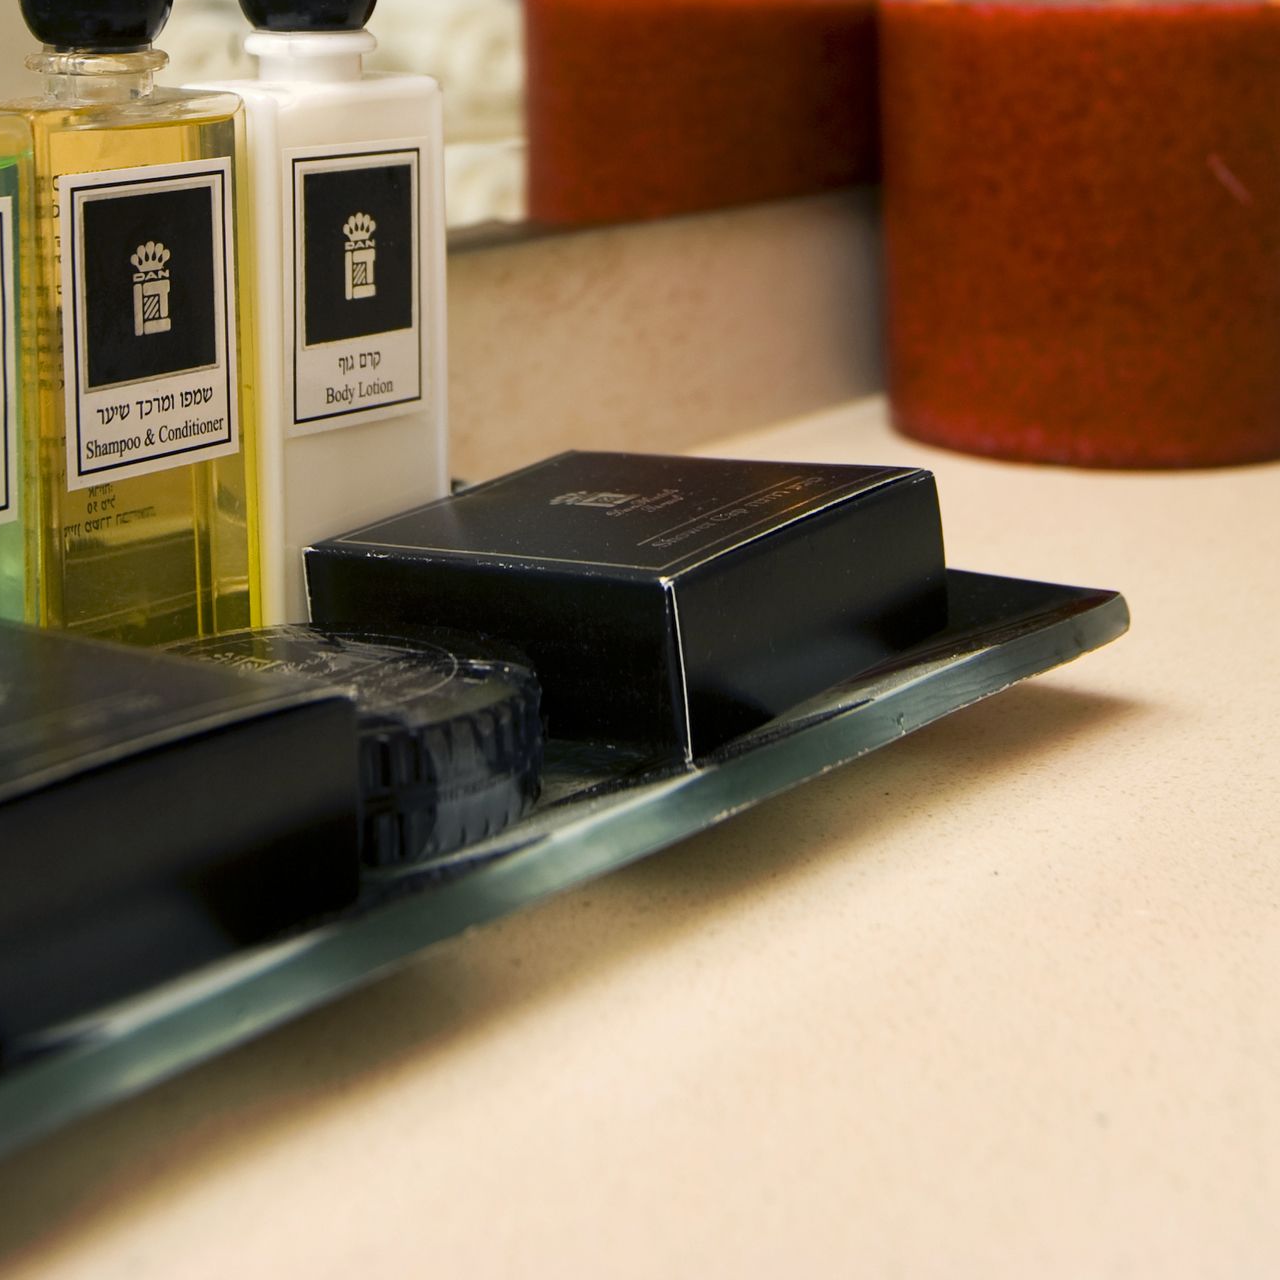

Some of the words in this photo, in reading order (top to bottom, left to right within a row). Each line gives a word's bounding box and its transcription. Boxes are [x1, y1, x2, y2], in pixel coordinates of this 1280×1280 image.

[344, 239, 376, 251] DAN
[132, 269, 170, 282] DAN
[338, 354, 355, 375] גוף
[359, 351, 381, 370] קרם
[180, 386, 213, 408] שמפו
[326, 384, 355, 405] Body
[358, 377, 393, 398] Lotion
[96, 403, 130, 426] שיער
[135, 393, 175, 420] ומרכך
[86, 435, 141, 460] Shampoo
[144, 428, 156, 447] &
[158, 417, 225, 444] Conditioner
